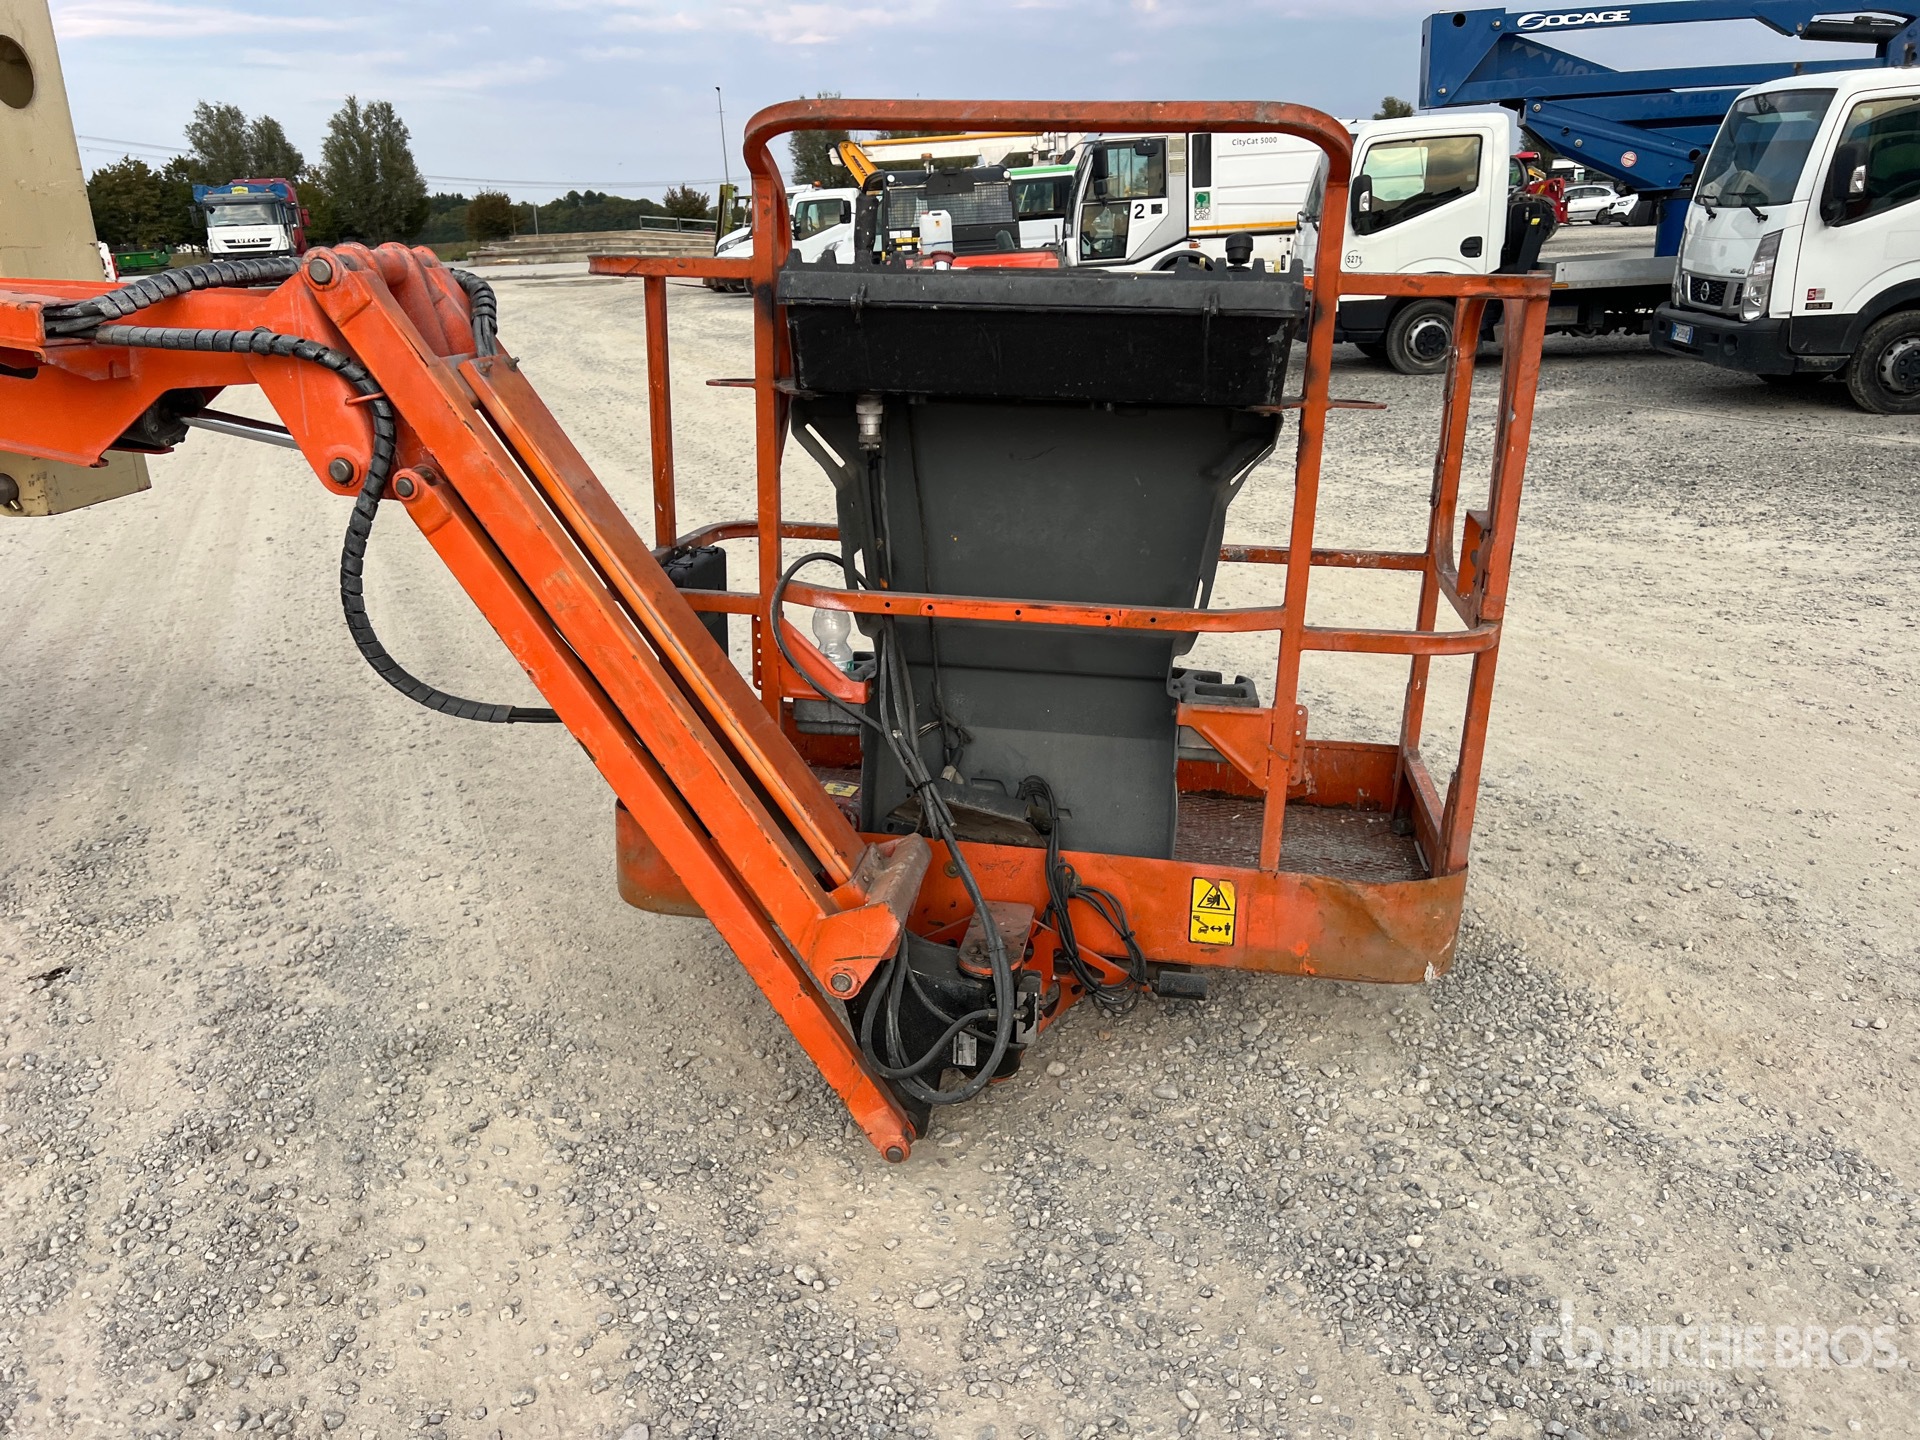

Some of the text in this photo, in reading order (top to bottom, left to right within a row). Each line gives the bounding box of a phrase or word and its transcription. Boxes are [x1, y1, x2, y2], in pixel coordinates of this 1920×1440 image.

[1517, 10, 1631, 30] SOCAGE
[1231, 136, 1278, 147] CityCat 5000
[1134, 203, 1145, 219] 2
